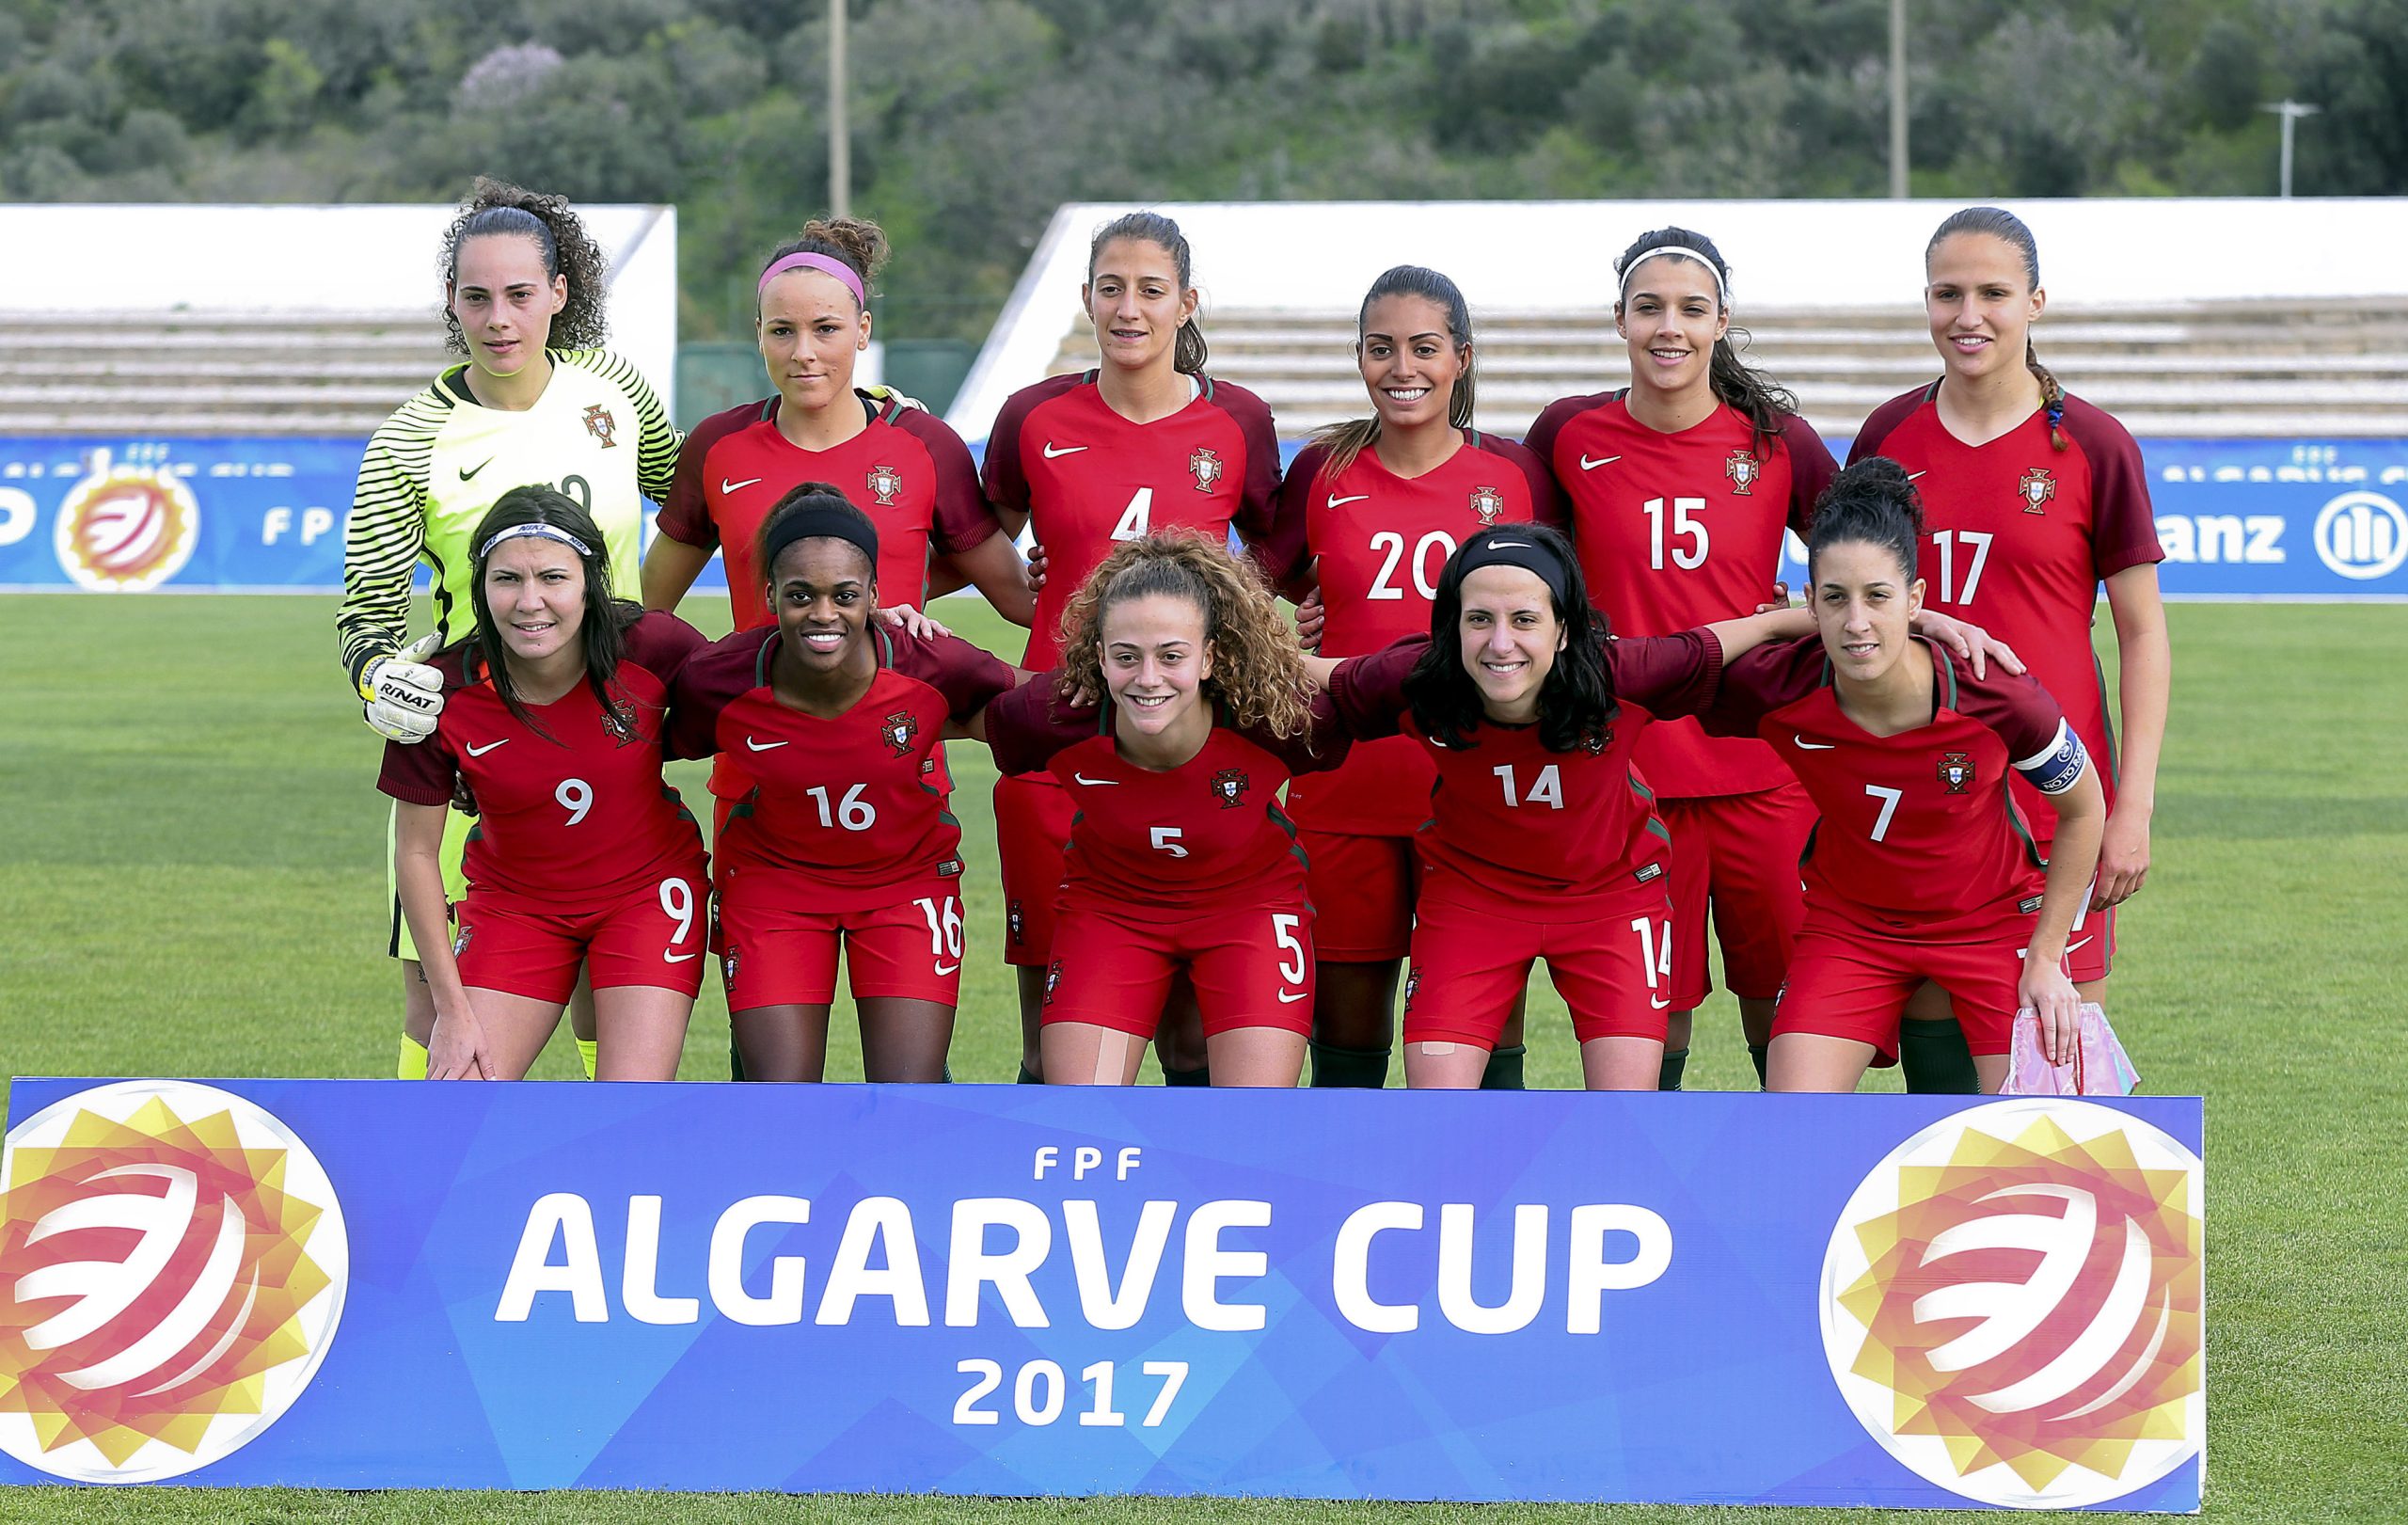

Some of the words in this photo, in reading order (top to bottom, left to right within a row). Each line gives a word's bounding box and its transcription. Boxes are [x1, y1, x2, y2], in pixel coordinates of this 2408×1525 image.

[261, 506, 354, 546] FP
[518, 524, 549, 533] NIKE
[1110, 487, 1153, 544] 4
[1643, 497, 1709, 570] 15
[1367, 530, 1458, 600] 20
[1933, 529, 1994, 605] 17
[380, 683, 436, 708] RINAT
[555, 778, 594, 826] 9
[806, 783, 876, 831] 16
[1493, 764, 1563, 810] 14
[2043, 779, 2063, 790] NO
[2061, 767, 2075, 780] TO
[1865, 784, 1903, 842] 7
[1149, 827, 1189, 857] 5
[658, 877, 693, 945] 9
[912, 896, 961, 959] 16
[1272, 913, 1306, 986] 5
[1034, 1146, 1142, 1181] FPF
[495, 1192, 1273, 1331] ALGARVE
[1334, 1201, 1673, 1335] CUP
[953, 1358, 1189, 1427] 2017
